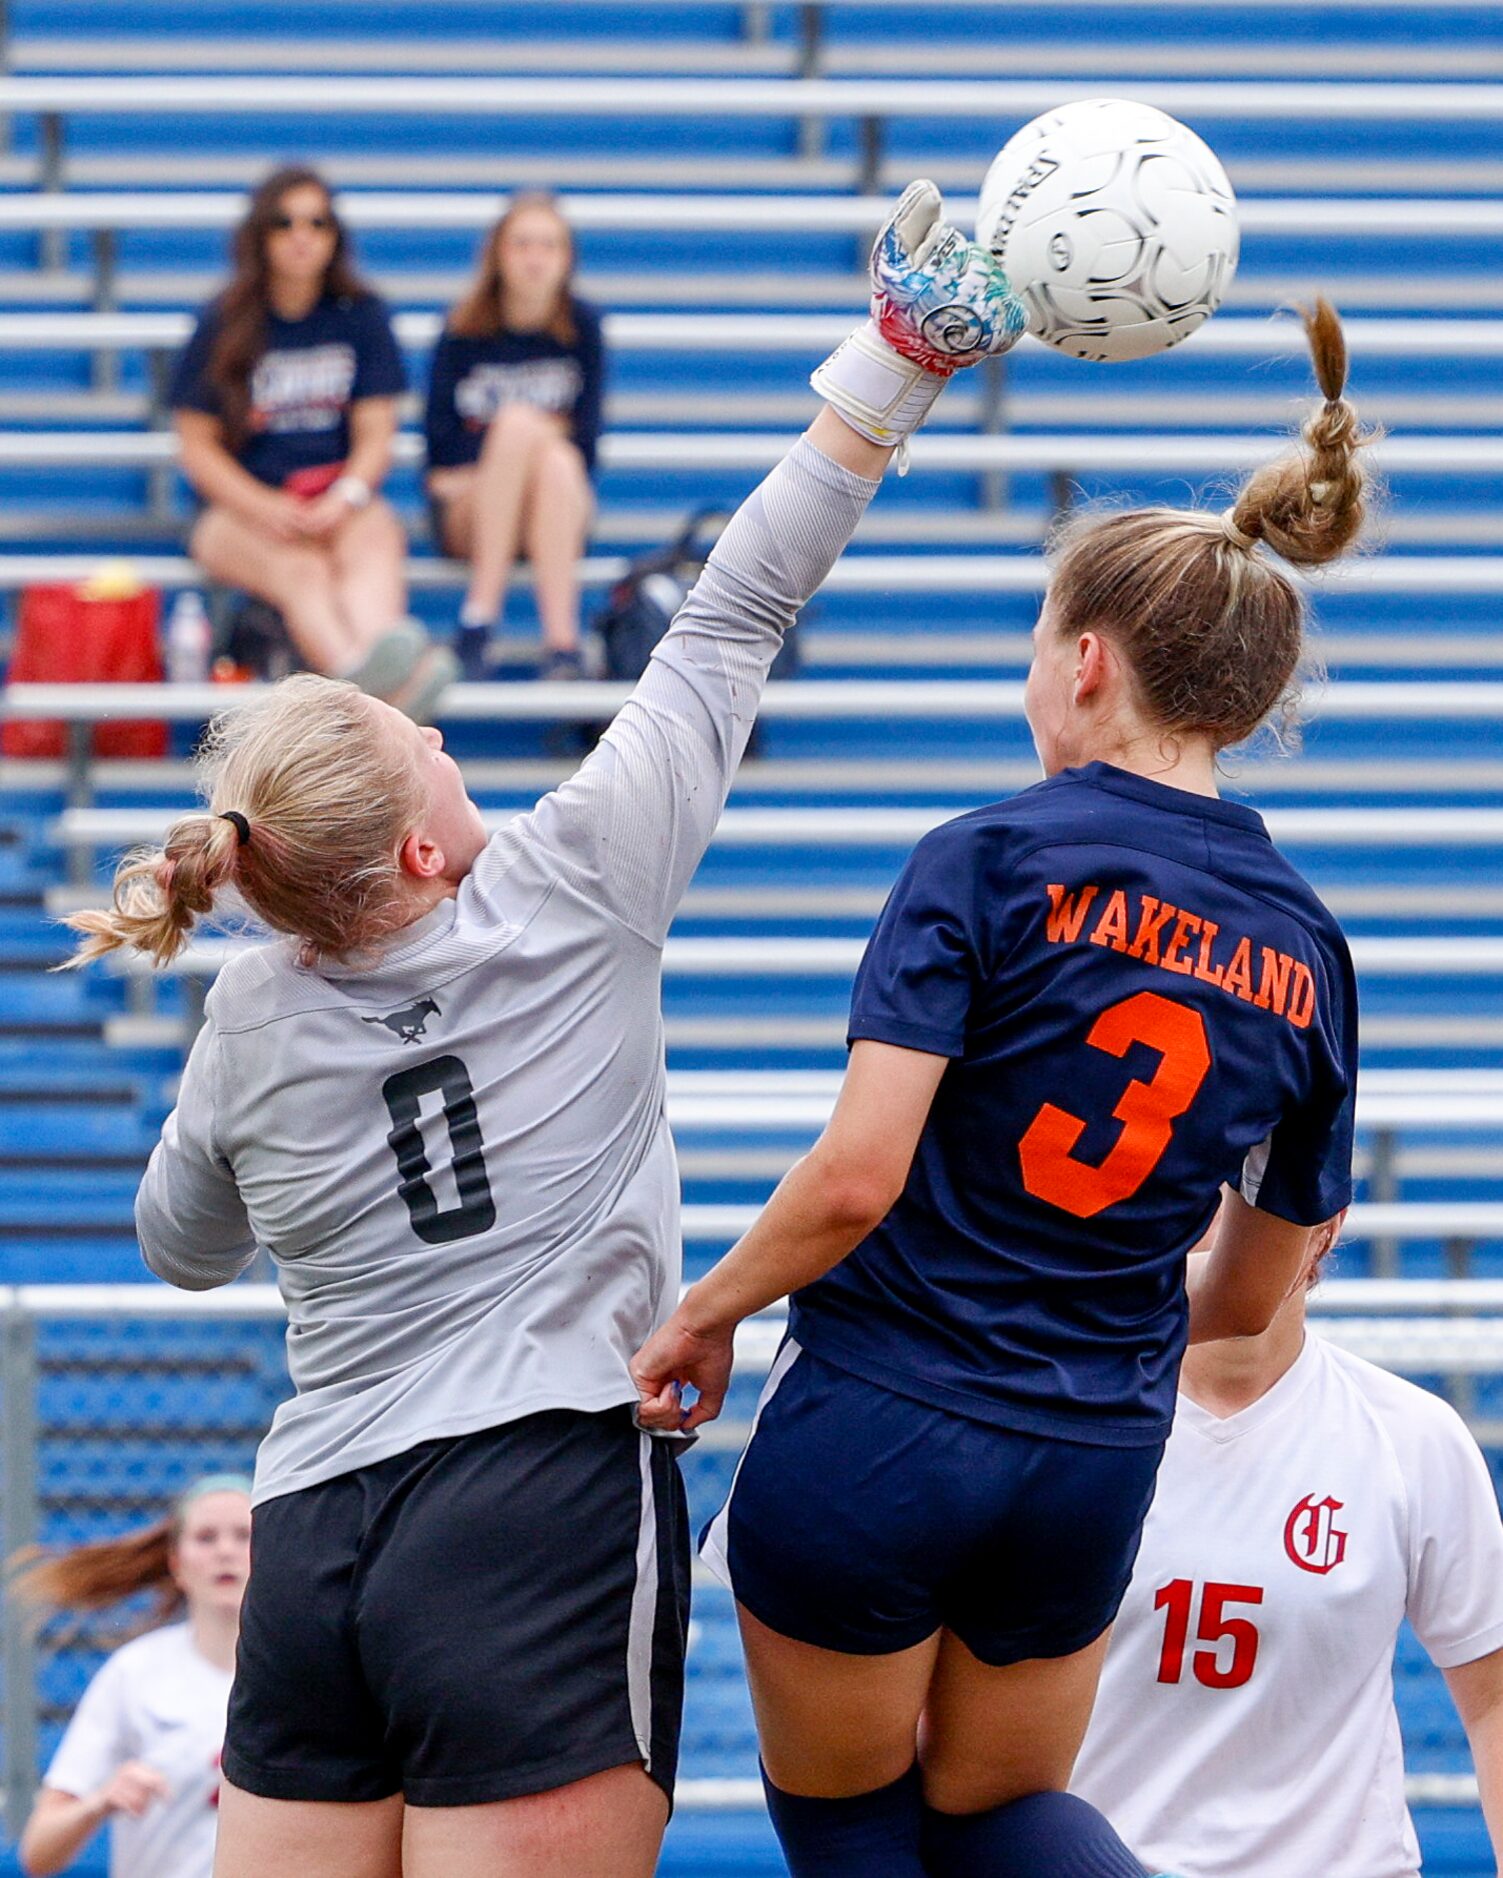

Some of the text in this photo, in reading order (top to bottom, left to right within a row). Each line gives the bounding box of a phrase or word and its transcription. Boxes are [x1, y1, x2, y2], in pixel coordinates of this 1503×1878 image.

[990, 149, 1060, 268] SPALDIN
[1046, 884, 1316, 1029] WAKELAND
[382, 1055, 496, 1245] 0
[1018, 991, 1212, 1219] 3
[1284, 1493, 1348, 1575] G
[1154, 1579, 1264, 1689] 15
